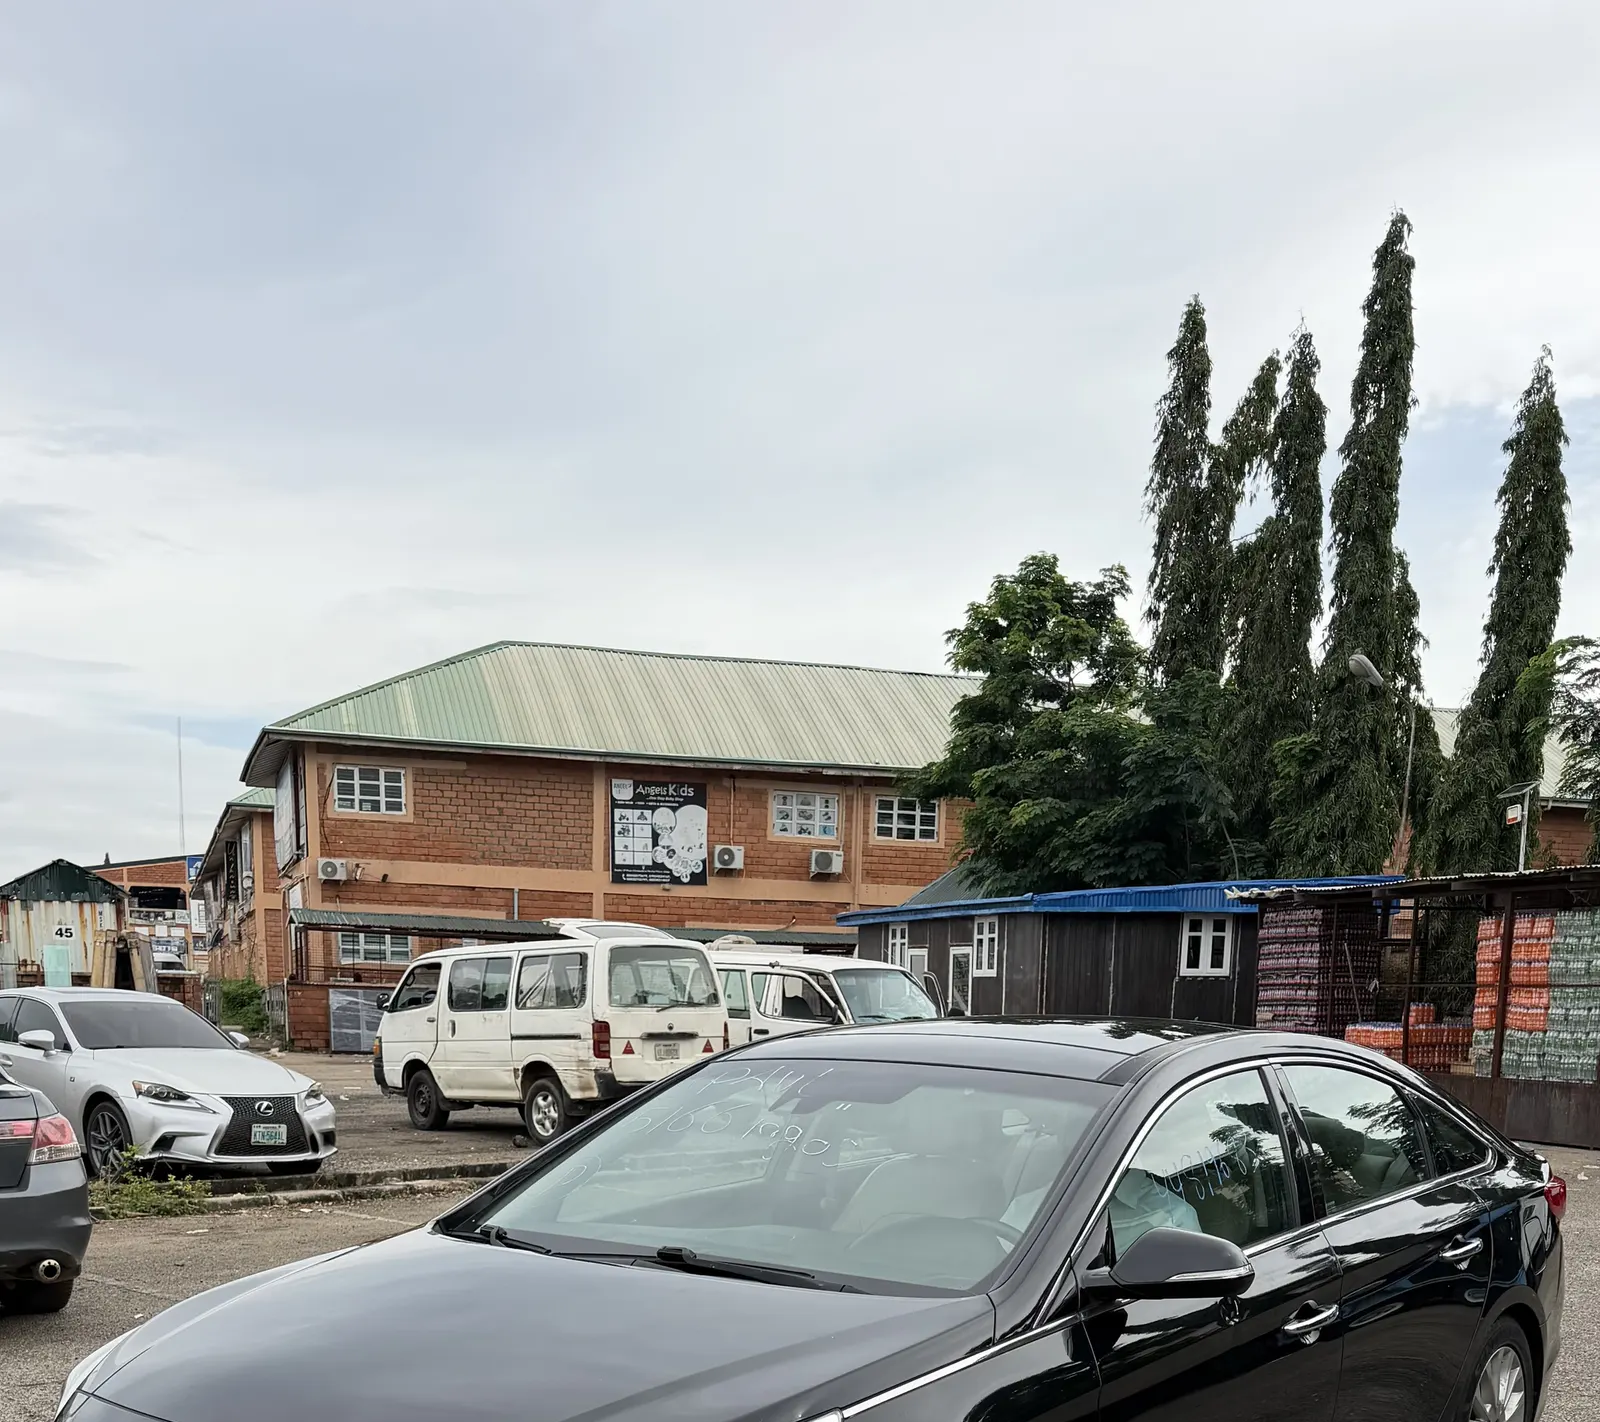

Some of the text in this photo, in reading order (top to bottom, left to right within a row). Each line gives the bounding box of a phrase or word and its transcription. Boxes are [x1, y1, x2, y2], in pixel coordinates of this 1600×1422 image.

[635, 784, 667, 796] Angels
[668, 783, 695, 797] Kids
[55, 927, 74, 938] 45
